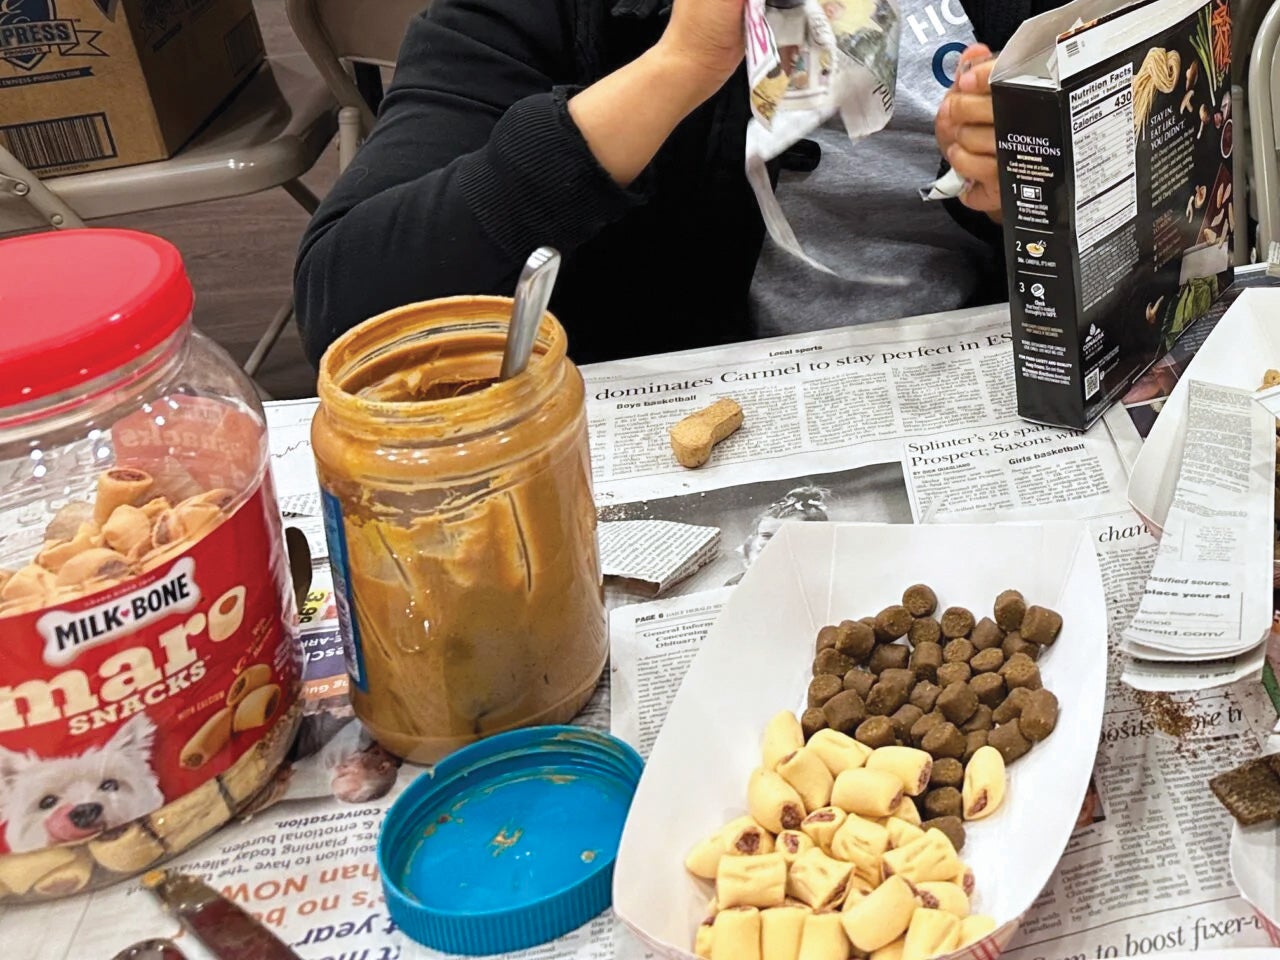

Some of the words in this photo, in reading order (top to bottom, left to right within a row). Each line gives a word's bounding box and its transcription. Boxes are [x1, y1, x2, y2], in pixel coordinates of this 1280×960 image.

[1071, 79, 1108, 103] Nutrition
[1109, 67, 1132, 83] Facts
[1073, 111, 1103, 131] Calories
[1114, 91, 1132, 107] 430
[1150, 110, 1164, 127] STAY
[1150, 125, 1162, 139] EAT
[1162, 115, 1176, 132] LIKE
[998, 140, 1062, 158] INSTRUCTIONS
[1007, 133, 1050, 147] COOKING
[1150, 132, 1164, 151] YOU
[1012, 183, 1018, 194] 1
[1016, 241, 1022, 252] 2
[1019, 282, 1026, 293] 3
[769, 349, 794, 357] Local
[795, 345, 823, 354] sports
[595, 377, 714, 401] dominates
[720, 362, 801, 384] Carmel
[809, 360, 830, 371] to
[836, 353, 875, 366] stay
[882, 343, 954, 363] perfect
[959, 340, 980, 351] in
[616, 401, 641, 410] Boys
[644, 395, 697, 406] basketball
[908, 433, 986, 455] Splinter's
[989, 430, 1010, 439] 26
[911, 447, 991, 467] Prospect;
[993, 437, 1052, 453] Saxons
[1009, 456, 1032, 465] Girls
[1034, 443, 1085, 459] basketball
[54, 608, 122, 650] MILK
[131, 572, 189, 620] BONE
[635, 614, 656, 623] PAGE
[643, 627, 680, 637] General
[69, 657, 207, 735] SNACKS
[276, 808, 378, 828] conversation.
[220, 833, 276, 852] burden.
[280, 822, 357, 845] emotional
[282, 836, 347, 856] Planning
[230, 846, 277, 866] today
[255, 858, 290, 871] have
[293, 857, 310, 865] to
[1125, 927, 1187, 952] boost
